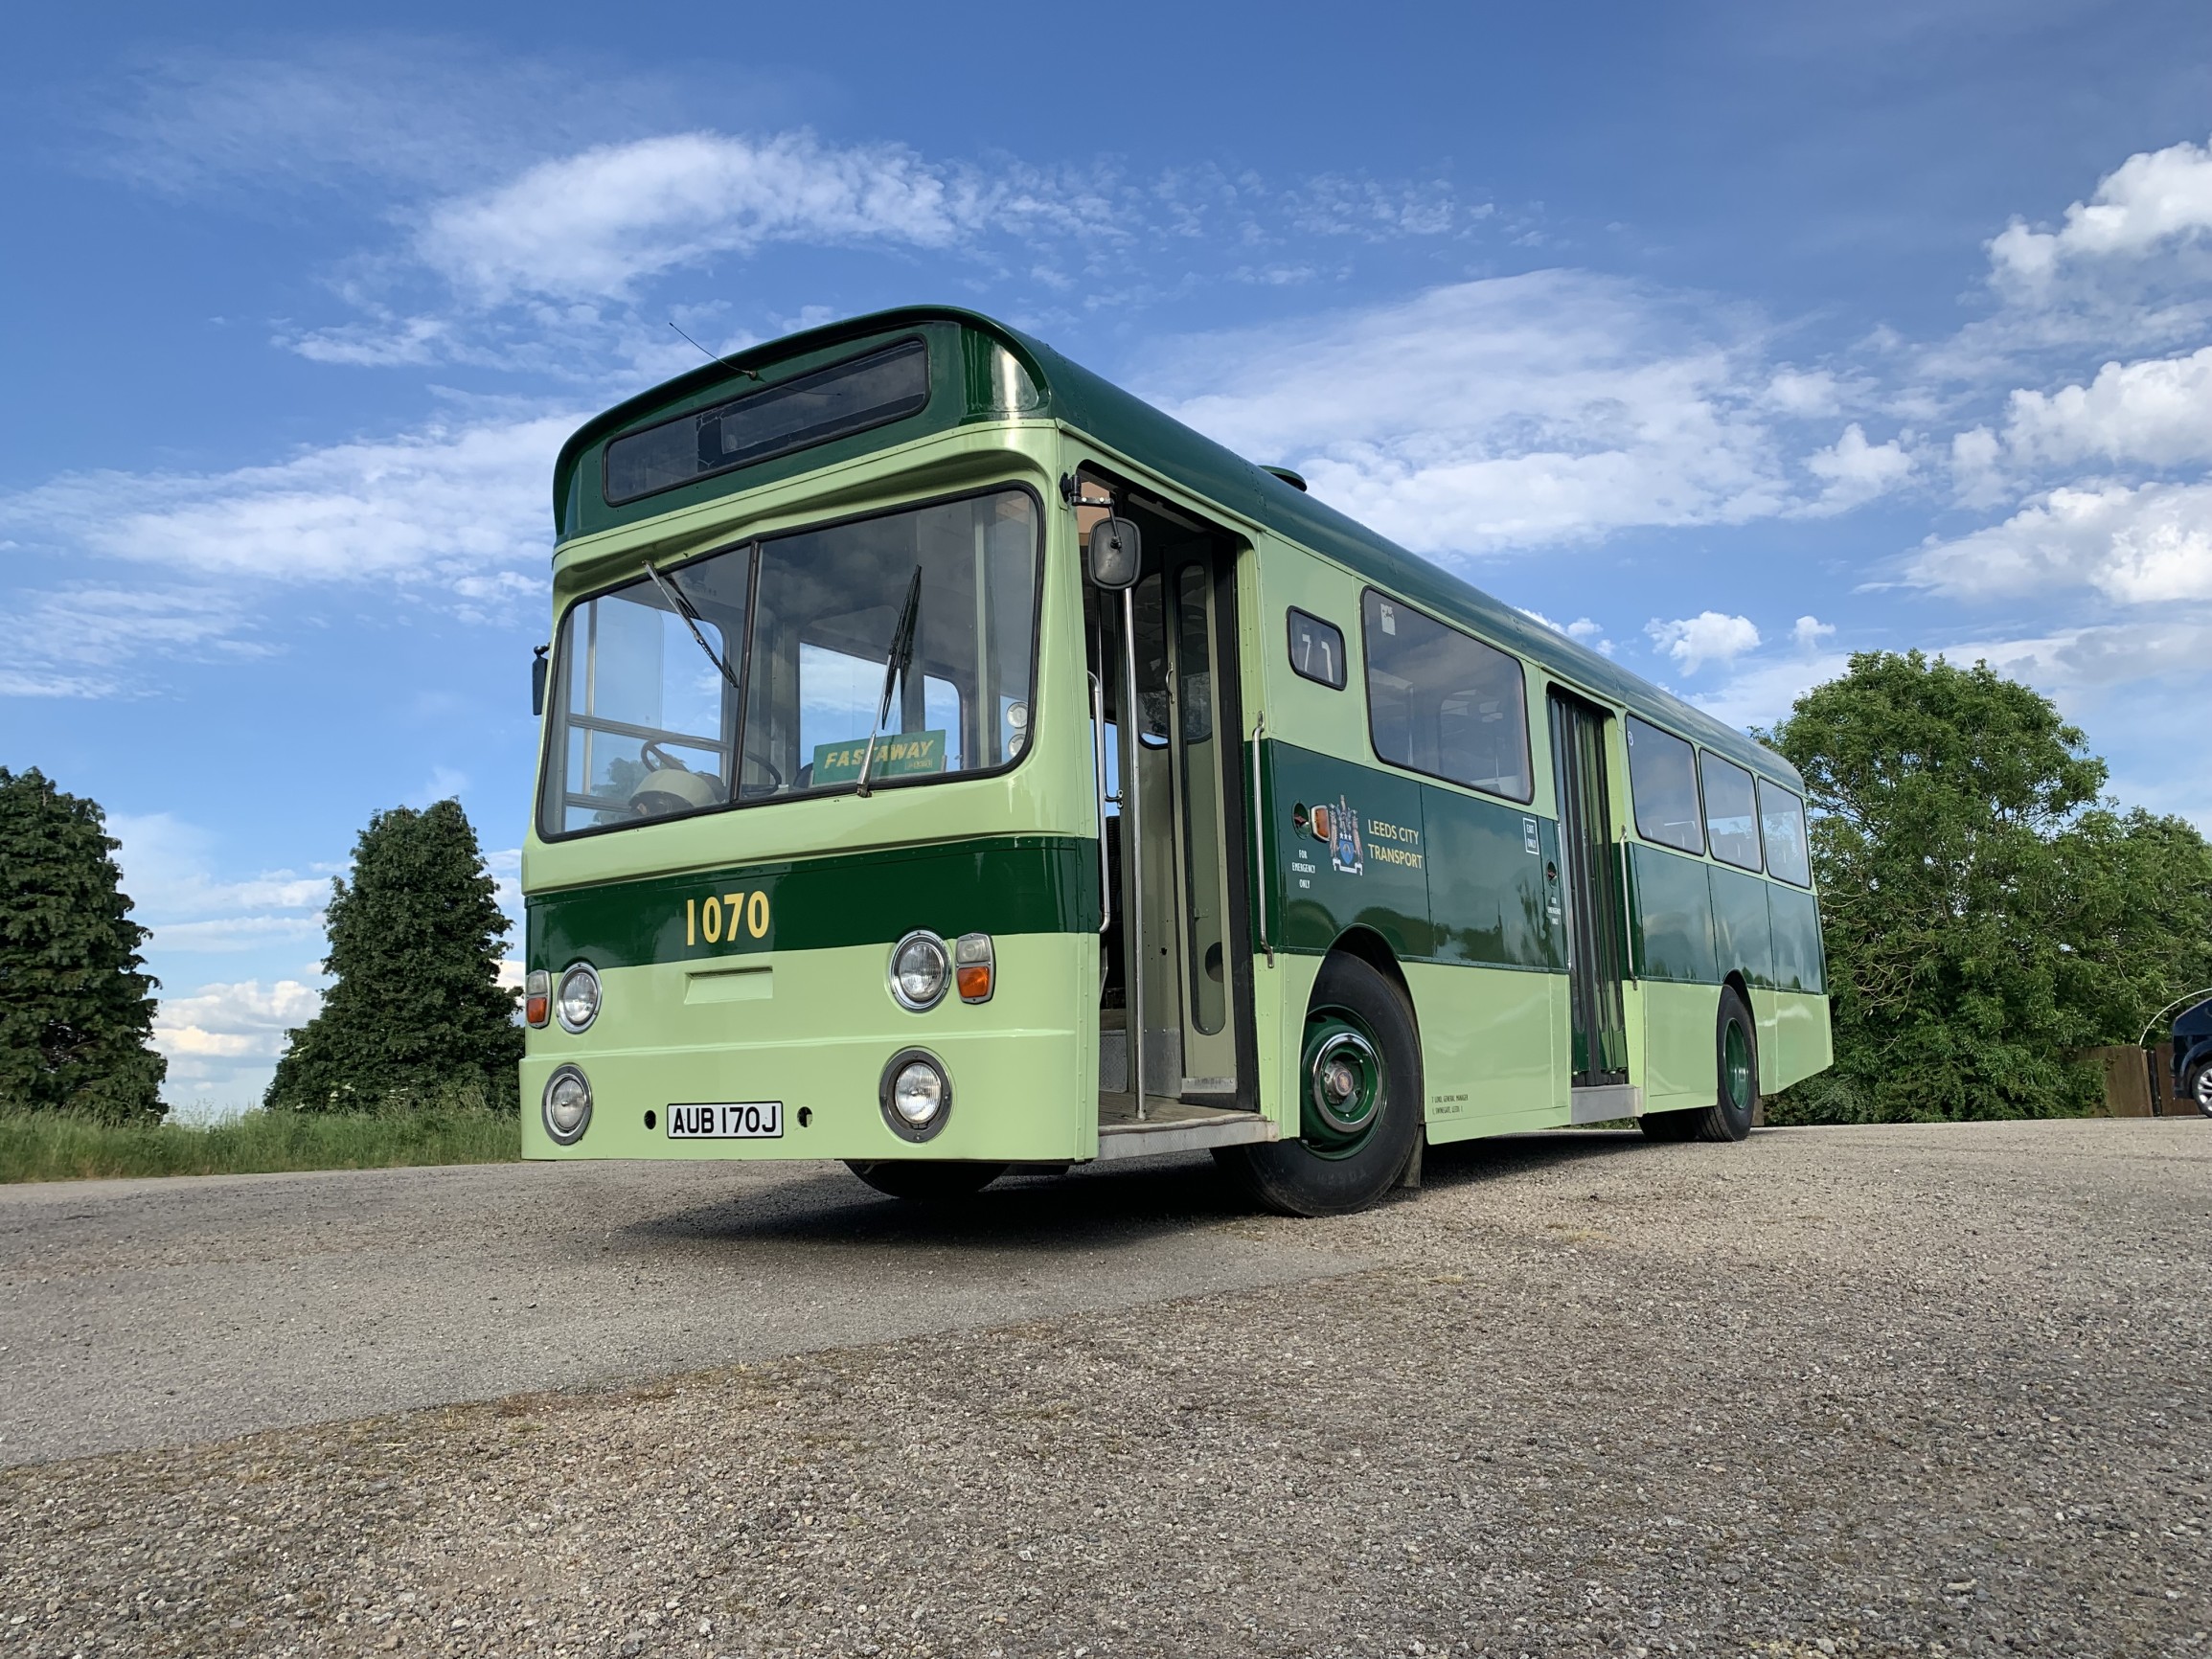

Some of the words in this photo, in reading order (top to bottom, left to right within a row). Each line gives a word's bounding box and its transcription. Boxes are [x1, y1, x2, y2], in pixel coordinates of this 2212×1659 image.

[824, 739, 934, 769] FASAWAY
[1367, 819, 1398, 840] LEEDS
[1399, 827, 1419, 845] CITY
[1298, 849, 1308, 859] FOR
[1367, 843, 1423, 869] TRANSPORT
[1291, 862, 1316, 874] EMERGENCY
[1299, 879, 1311, 889] ONLY
[687, 891, 769, 946] 1070
[673, 1107, 714, 1133] AUB
[722, 1106, 776, 1133] 170J
